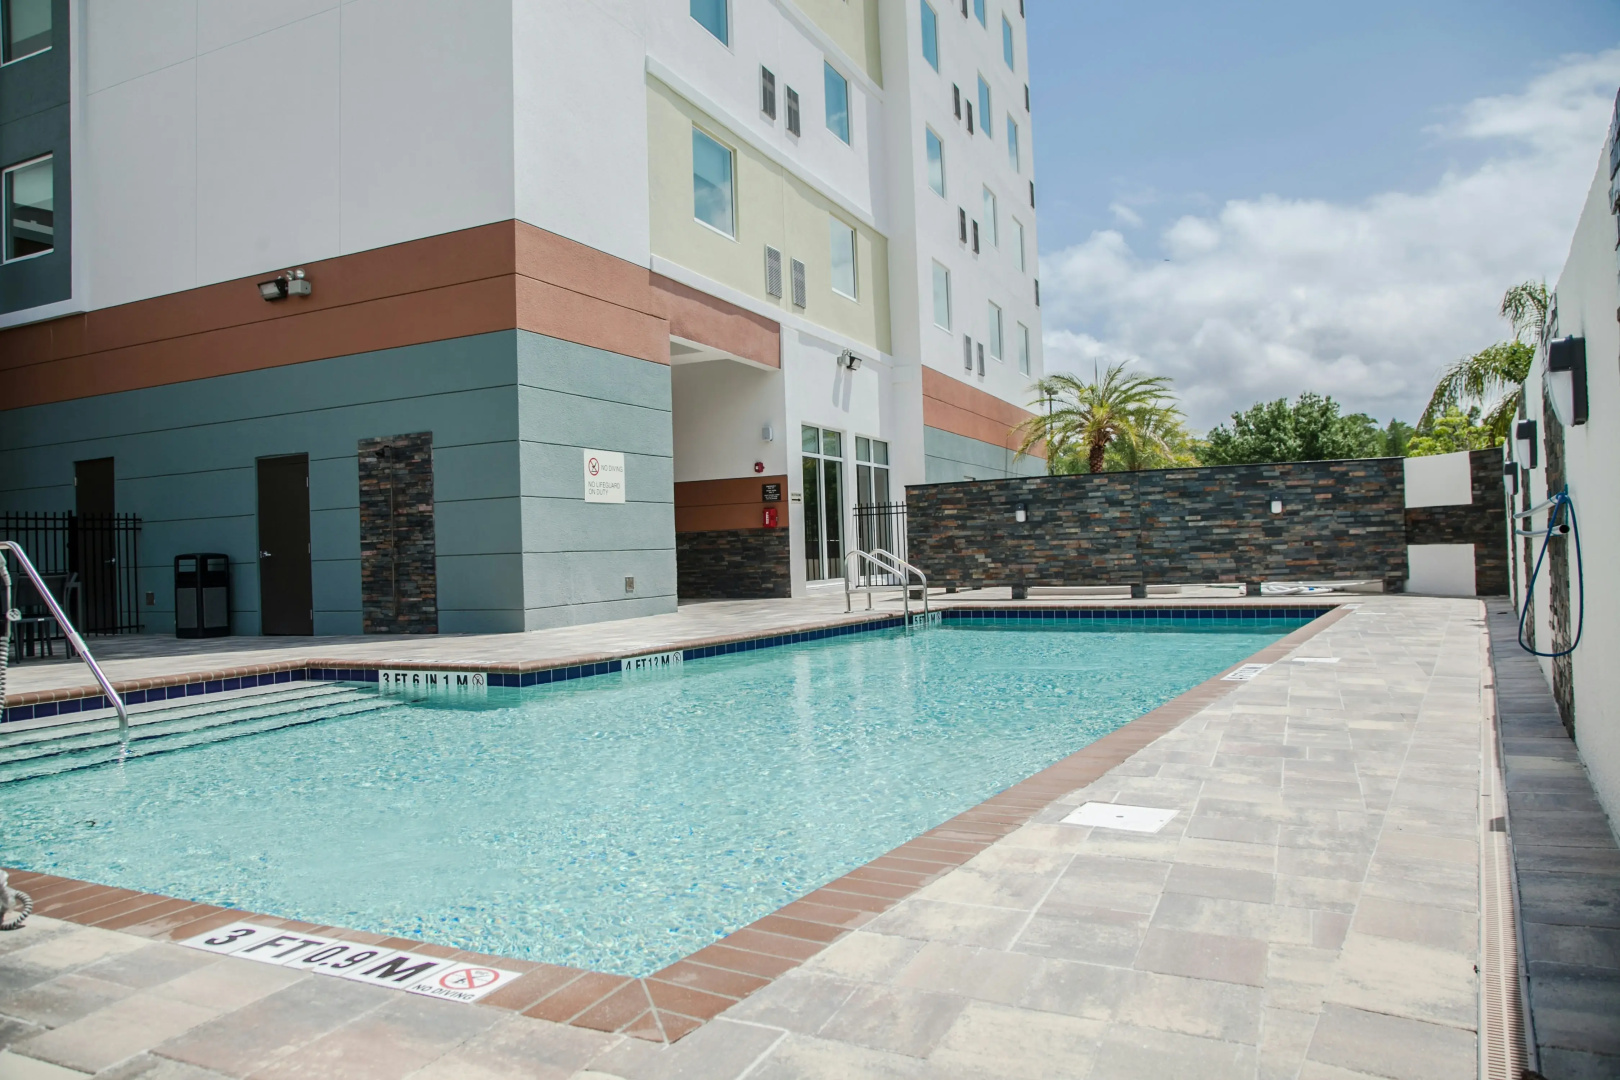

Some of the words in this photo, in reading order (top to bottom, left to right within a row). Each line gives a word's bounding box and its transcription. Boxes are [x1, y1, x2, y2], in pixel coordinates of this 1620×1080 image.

[635, 658, 647, 669] FT
[661, 654, 670, 665] M
[382, 672, 390, 683] 3
[394, 673, 408, 684] FT
[412, 673, 420, 685] 6
[425, 673, 438, 685] IN
[443, 674, 449, 685] 1
[456, 674, 468, 686] M
[204, 928, 257, 946] 3
[241, 935, 325, 959] FT
[302, 945, 379, 969] 0.9
[360, 956, 438, 983] M
[411, 984, 433, 992] NO
[430, 988, 476, 1001] DIVING
